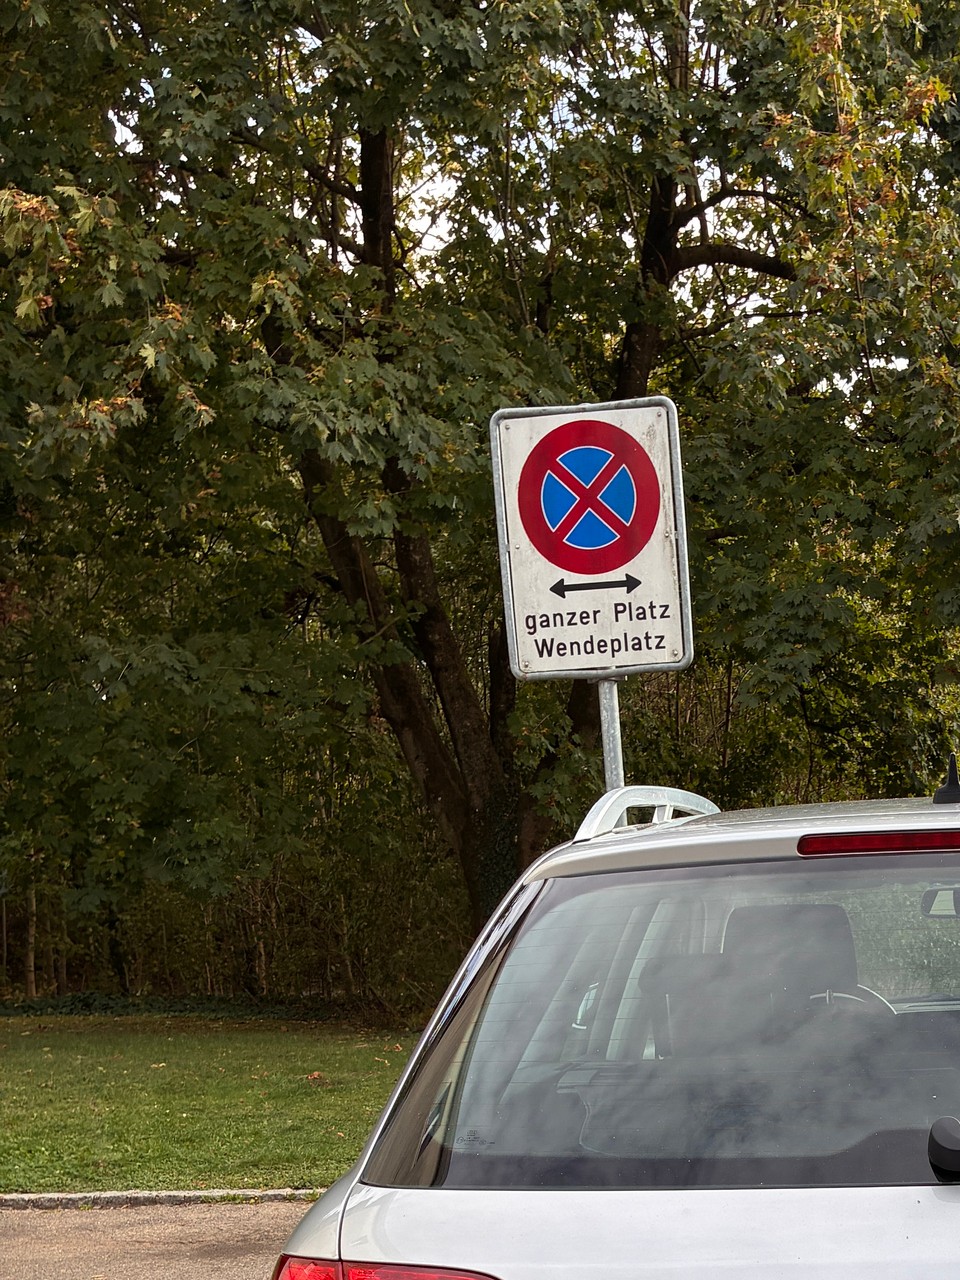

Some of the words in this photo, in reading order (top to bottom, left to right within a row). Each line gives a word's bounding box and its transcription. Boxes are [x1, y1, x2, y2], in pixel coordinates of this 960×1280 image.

[525, 608, 601, 635] ganzer
[614, 600, 671, 623] Platz
[534, 630, 667, 659] Wendeplatz
